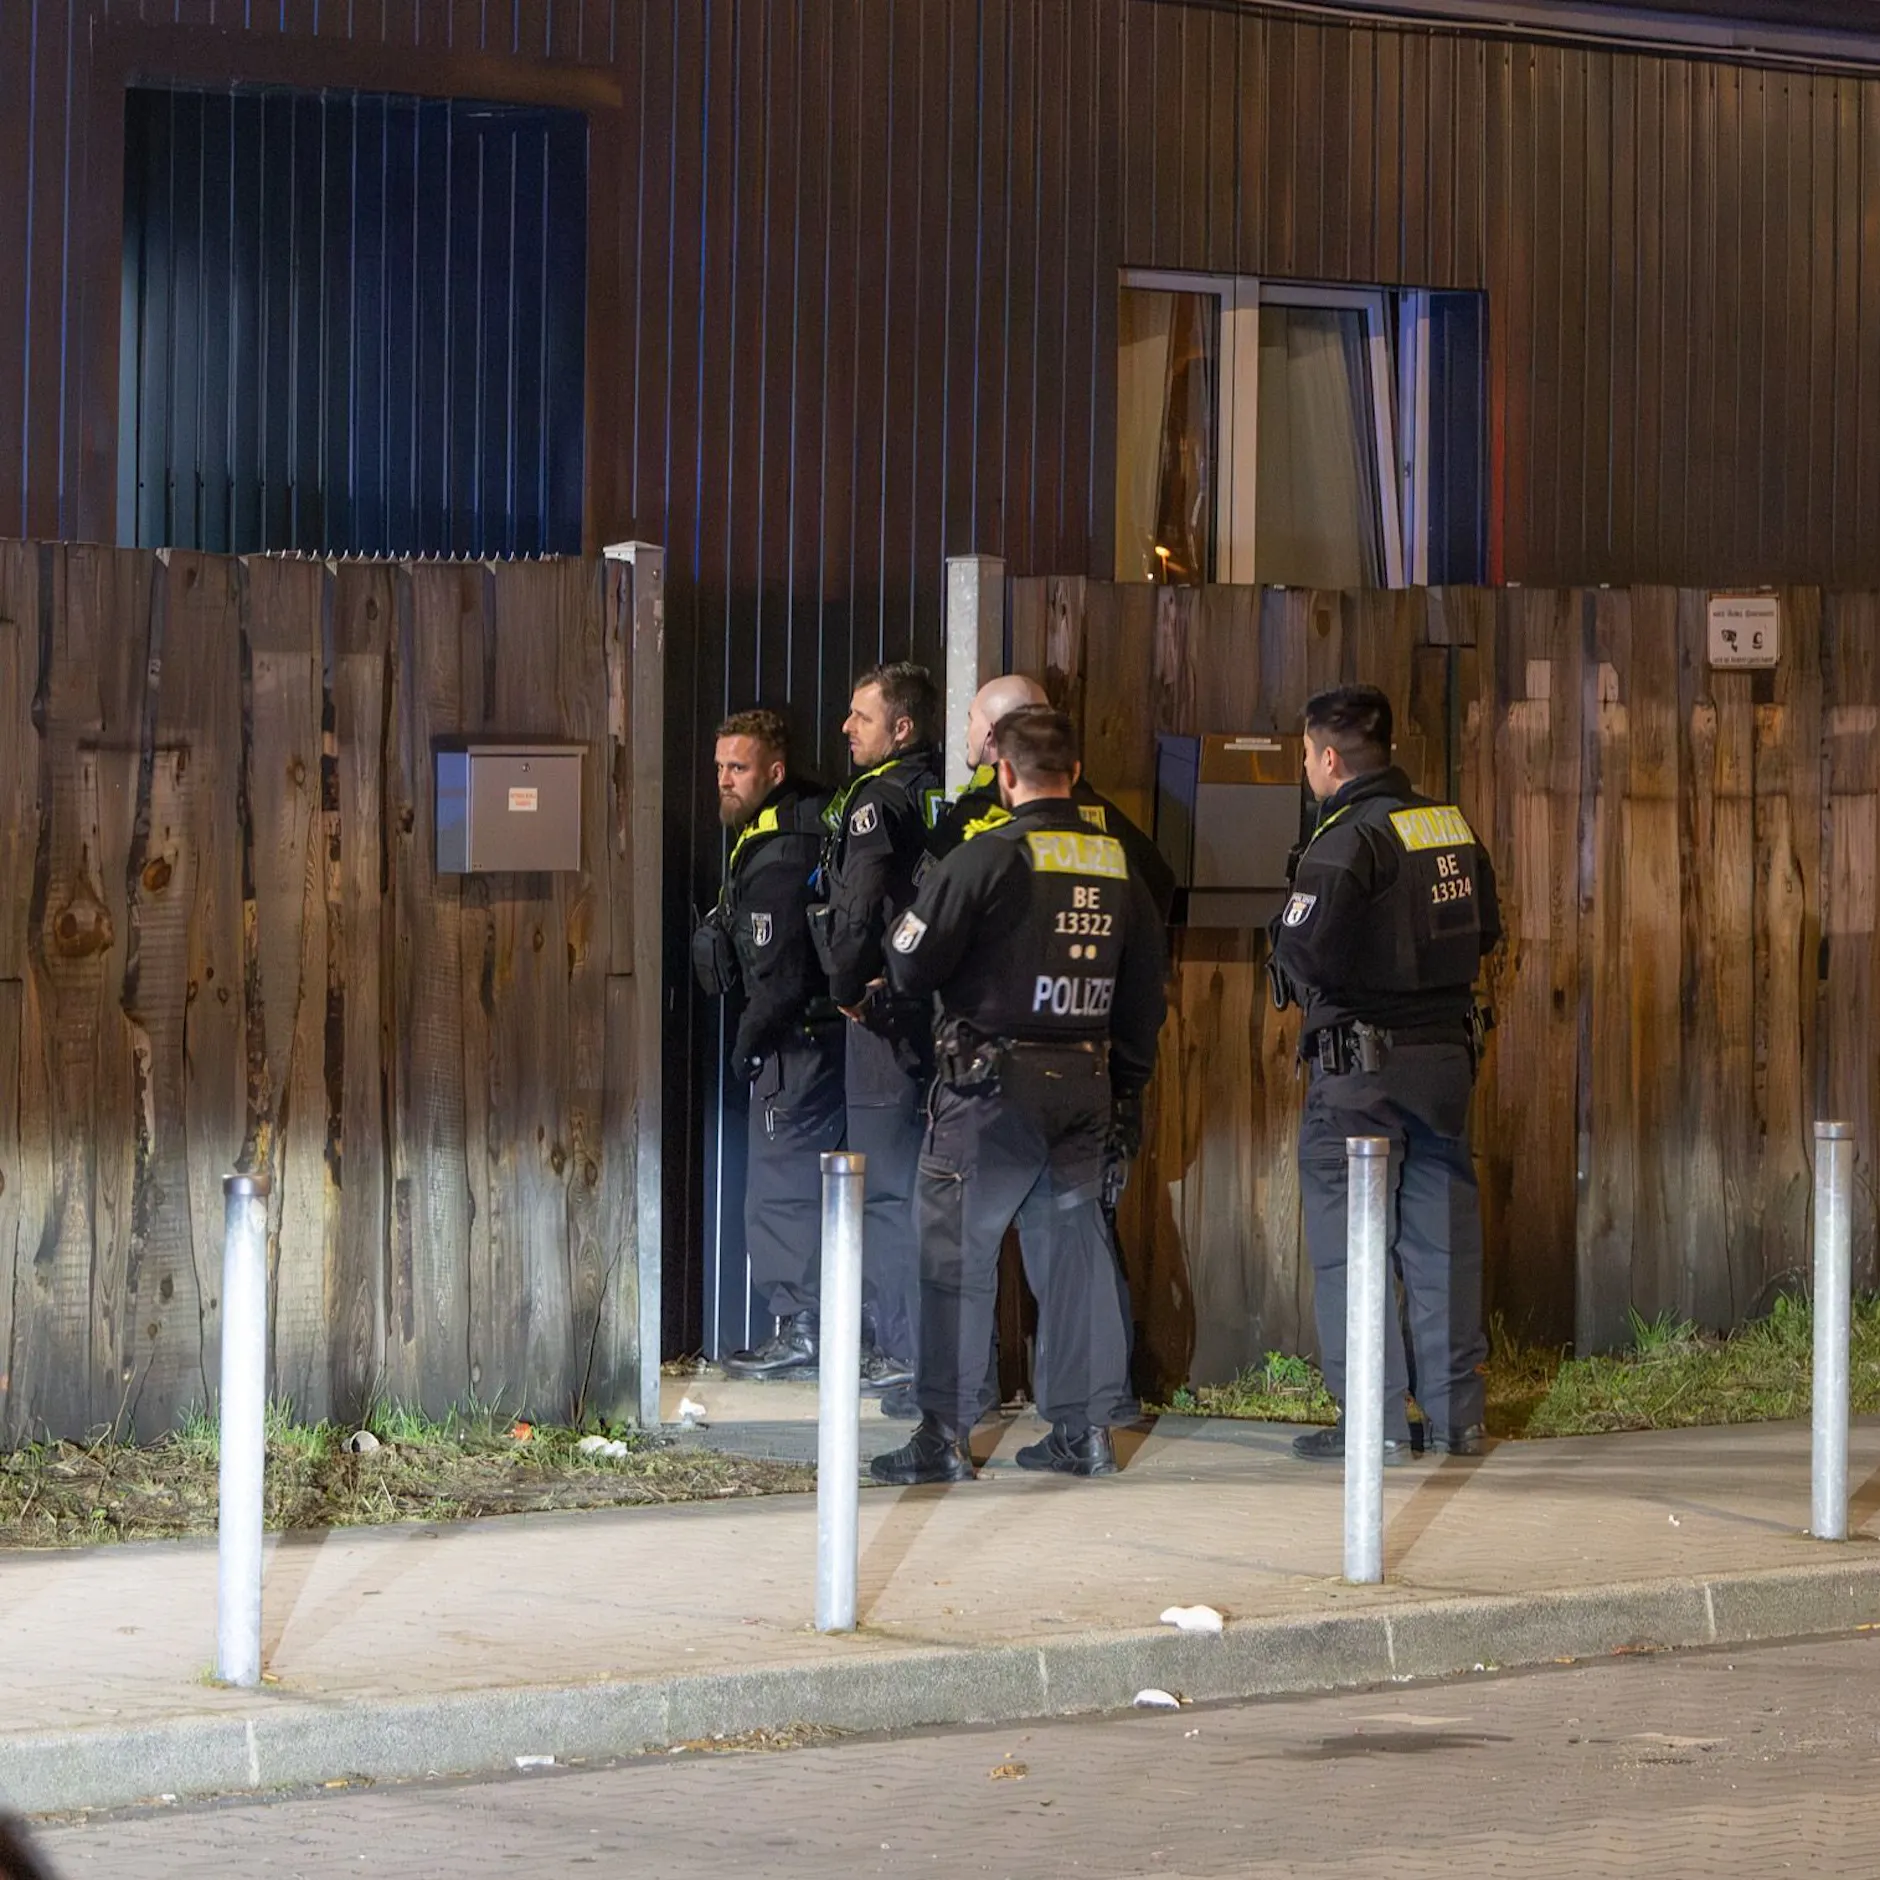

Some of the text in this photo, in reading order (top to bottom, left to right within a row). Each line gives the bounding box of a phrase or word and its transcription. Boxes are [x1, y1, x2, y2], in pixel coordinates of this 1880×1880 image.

[1436, 853, 1460, 878] BE
[1072, 885, 1101, 910] BE
[1431, 876, 1472, 904] 13324
[1054, 911, 1113, 936] 13322
